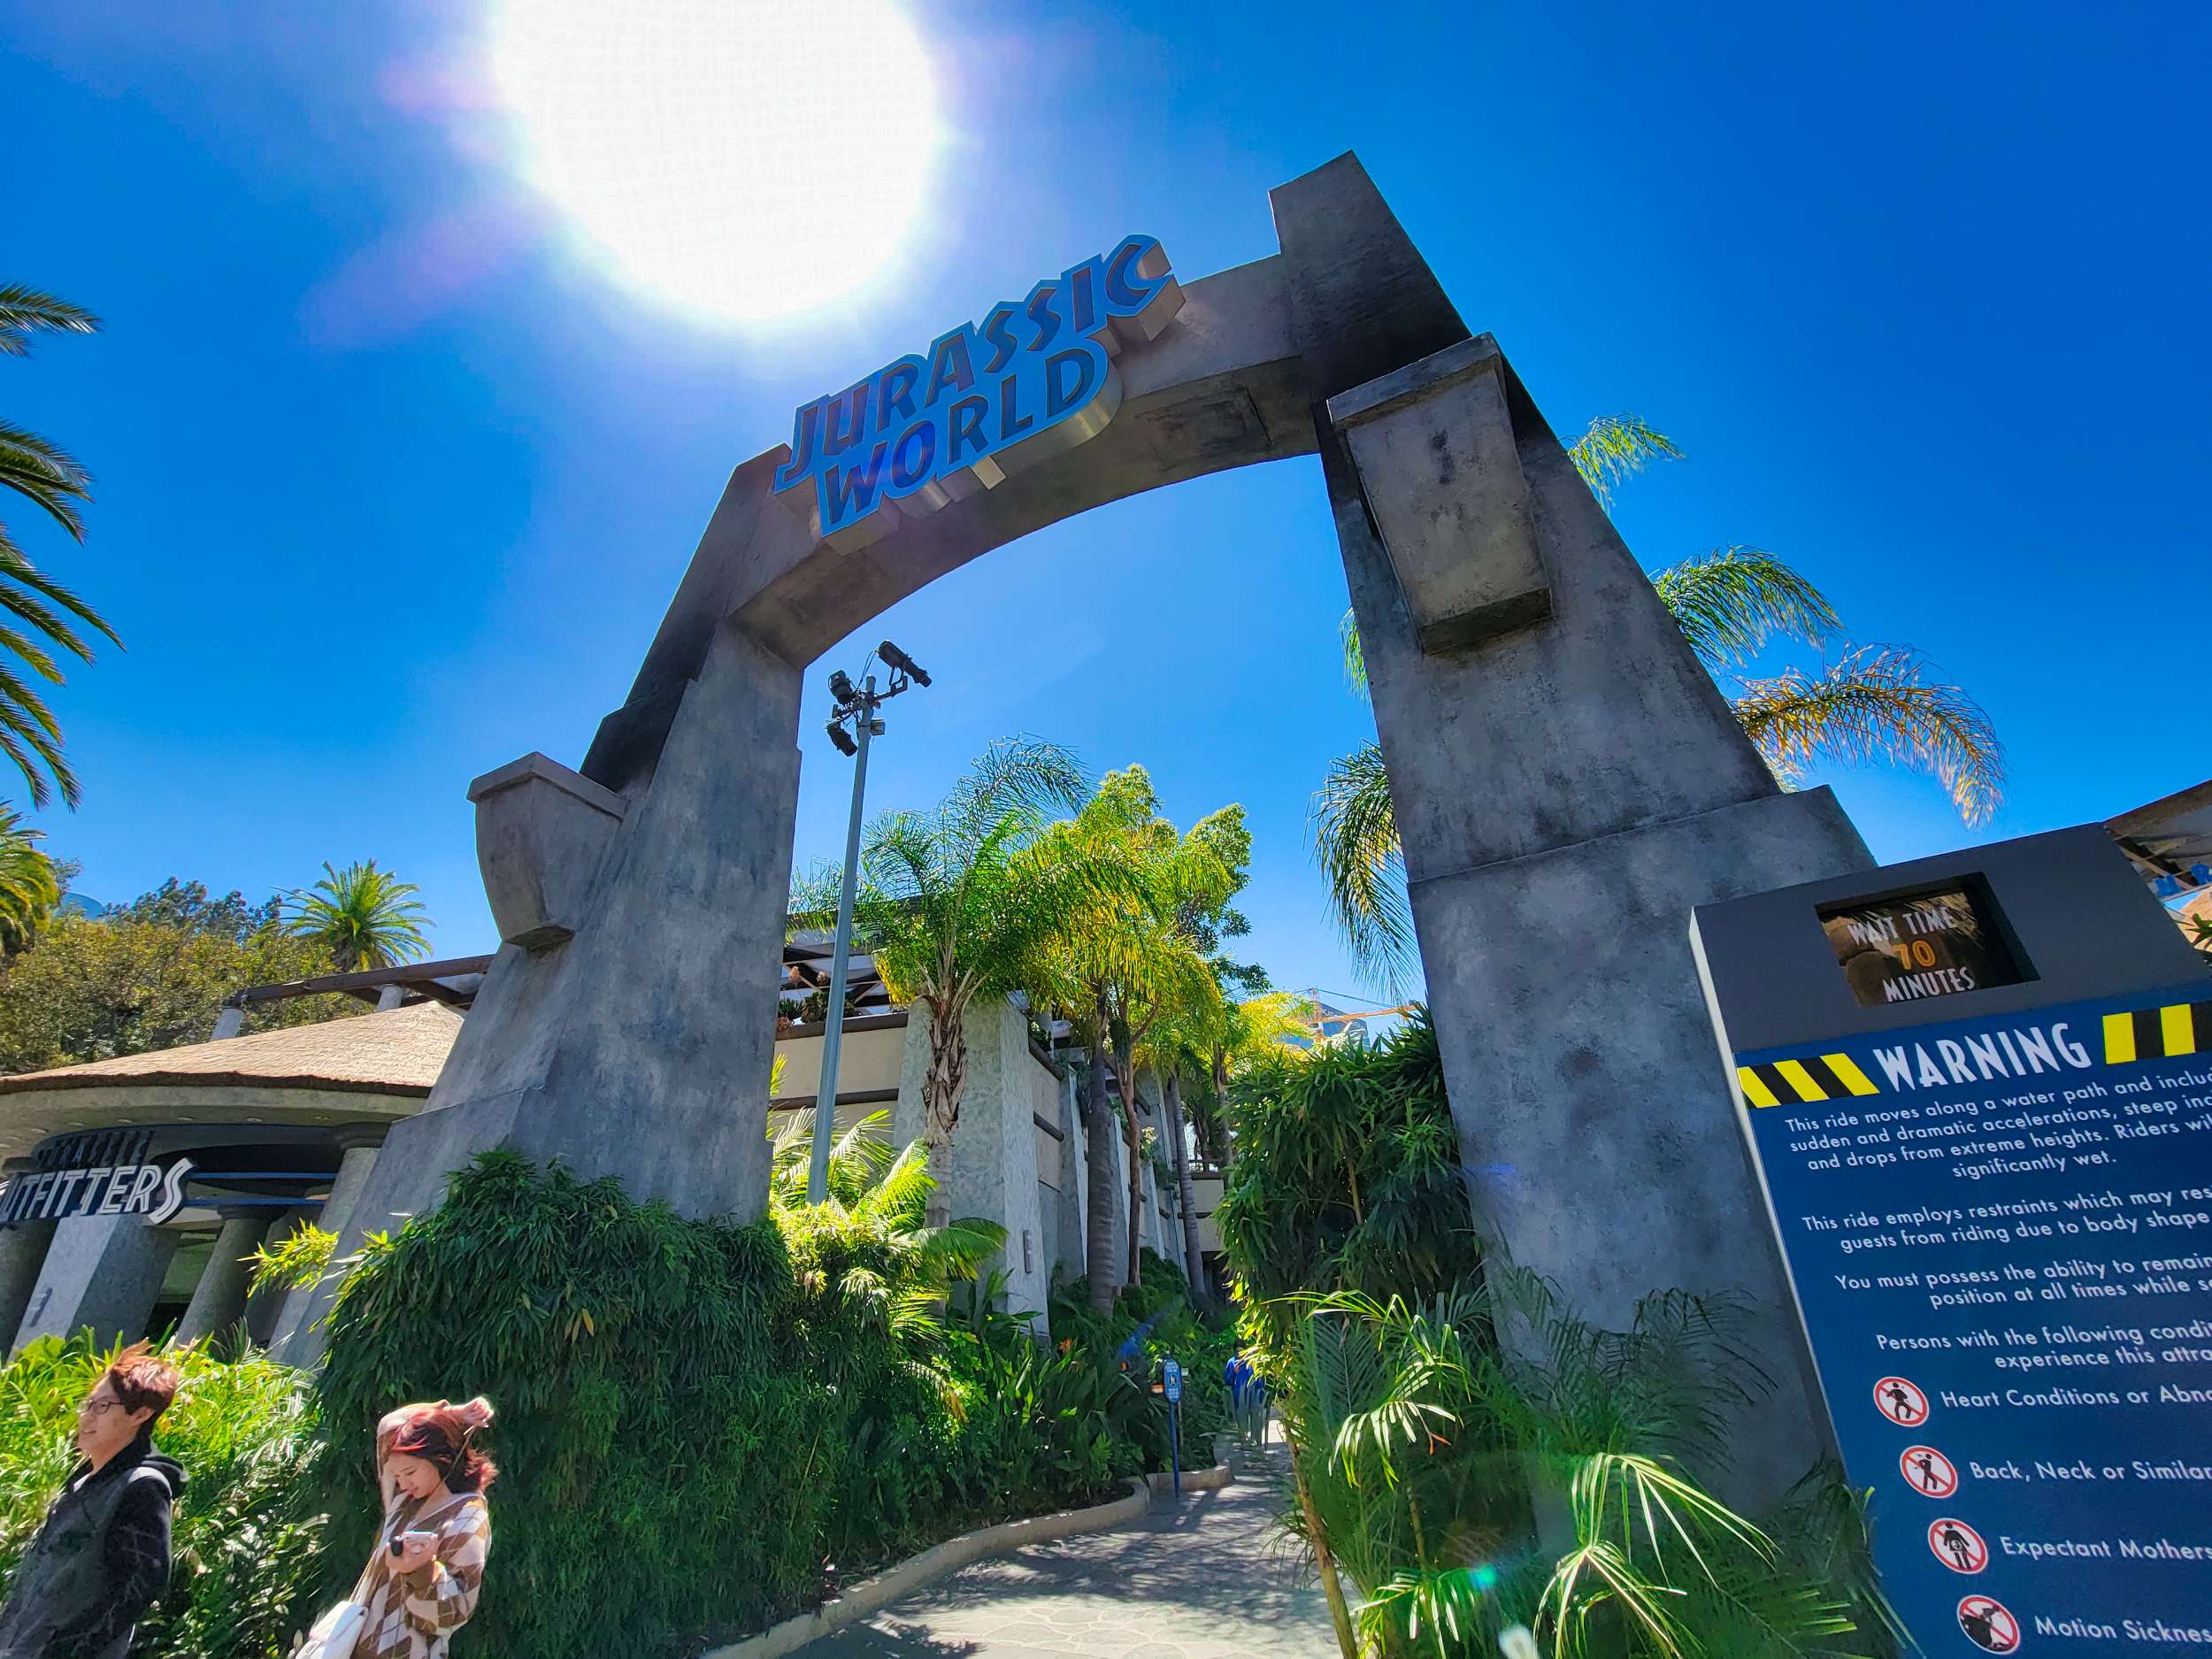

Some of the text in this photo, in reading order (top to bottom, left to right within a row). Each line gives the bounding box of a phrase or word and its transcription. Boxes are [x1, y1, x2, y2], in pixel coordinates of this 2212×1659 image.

[779, 239, 1159, 485] JURASSIC
[824, 349, 1095, 525] WORLD
[1847, 905, 1957, 946] WAIT TIME
[1893, 940, 1936, 970] 70
[1882, 966, 1976, 1003] MINUTES
[1872, 1023, 2093, 1093] WARNING
[1786, 1118, 1819, 1133] This
[1824, 1112, 1858, 1128] ride
[1864, 1107, 1919, 1124] moves
[1925, 1101, 1978, 1116] along
[1984, 1100, 1997, 1110] a
[2001, 1091, 2055, 1107] water
[2063, 1081, 2108, 1104] path
[2115, 1076, 2152, 1094] and
[1790, 1090, 2212, 1152] sudden and dramatic accelerations, steep inc
[1808, 1154, 1839, 1171] and
[1847, 1151, 1897, 1167] drops
[1901, 1145, 1944, 1161] from
[1951, 1136, 2025, 1156] extreme
[2030, 1128, 2109, 1148] heights.
[2114, 1121, 2179, 1140] Riders
[1953, 1150, 2117, 1180] significantly wet.
[0, 1157, 193, 1225] UTFITTERS
[1801, 1215, 1838, 1232] This
[1843, 1211, 1879, 1228] ride
[1886, 1206, 1962, 1226] employs
[1969, 1199, 2058, 1218] restraints
[2063, 1191, 2124, 1210] which
[2130, 1191, 2172, 1207] may
[1840, 1210, 2210, 1254] guests from riding due to body shape
[1834, 1253, 2212, 1290] You must possess the ability to remain
[1930, 1288, 2007, 1310] position
[2014, 1287, 2034, 1302] at
[2040, 1283, 2066, 1299] all
[2071, 1283, 2127, 1298] times
[2132, 1275, 2191, 1294] while
[1876, 1333, 1952, 1351] Persons
[1956, 1329, 2000, 1348] with
[2004, 1328, 2038, 1347] the
[2042, 1325, 2144, 1346] following
[1994, 1350, 2110, 1371] experience
[2115, 1347, 2155, 1364] this
[1940, 1390, 2000, 1408] Heart
[2006, 1387, 2120, 1407] Conditions
[2126, 1389, 2149, 1403] or
[1969, 1460, 2212, 1482] Back, Neck or Similar
[2000, 1536, 2212, 1561] Expectant Mothers
[2034, 1615, 2117, 1638] Motion
